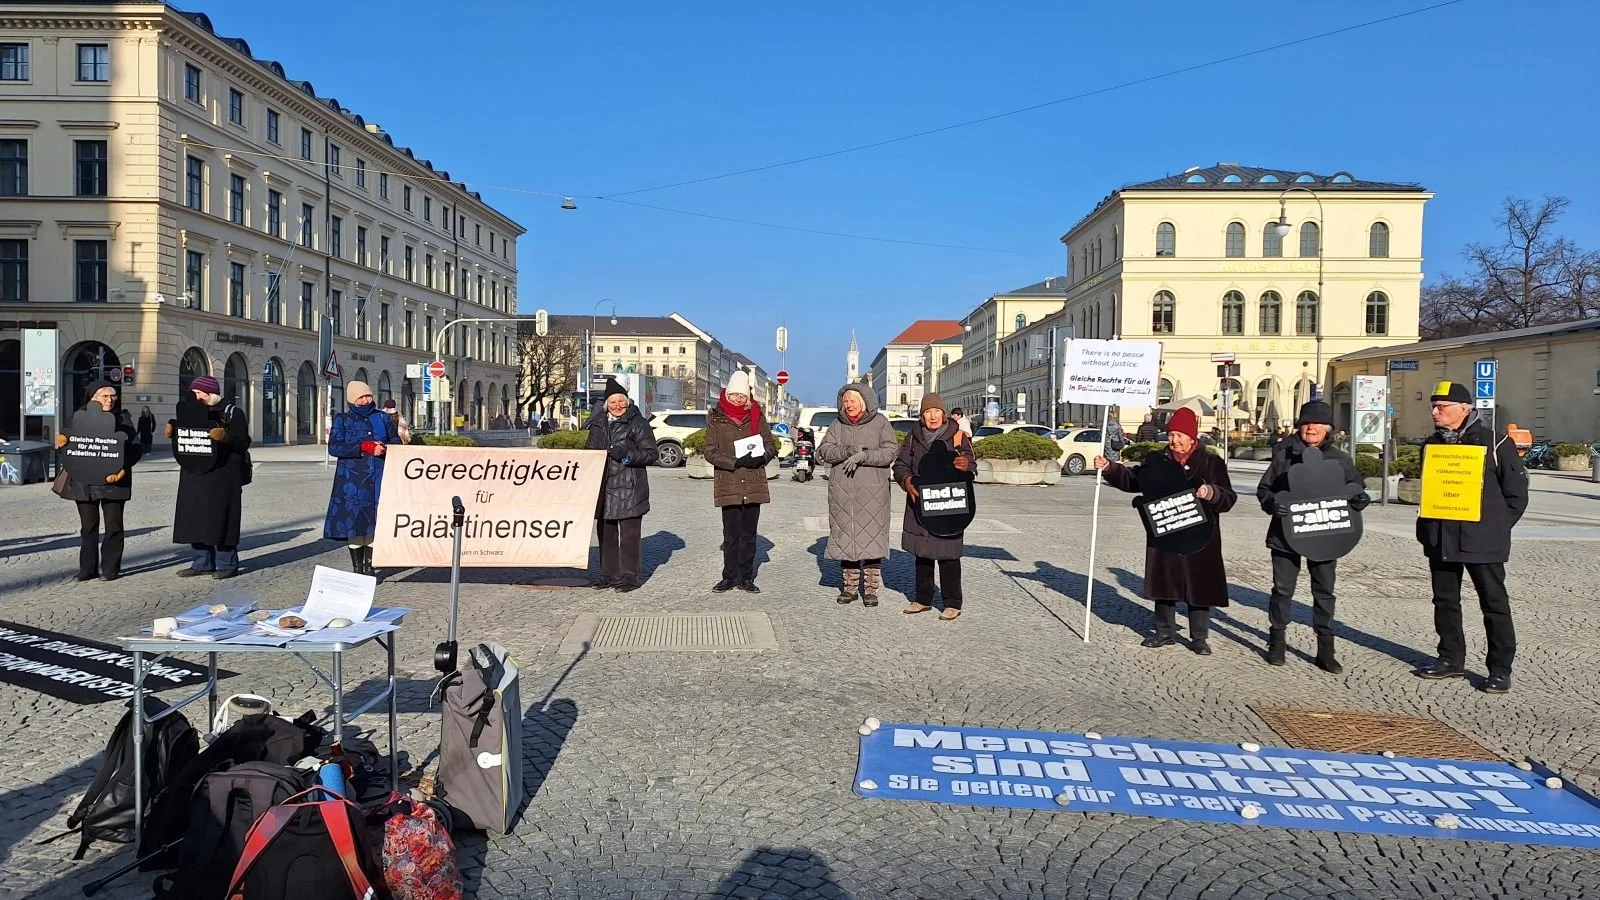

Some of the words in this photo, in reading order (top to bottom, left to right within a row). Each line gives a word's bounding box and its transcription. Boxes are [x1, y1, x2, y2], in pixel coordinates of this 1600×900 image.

[1081, 349, 1102, 357] There
[1480, 364, 1492, 377] U
[1070, 375, 1096, 383] Gleiche
[1123, 377, 1136, 385] für
[178, 429, 188, 437] End
[184, 445, 212, 454] Palestine
[404, 458, 580, 486] Gerechtigkeit
[475, 490, 495, 504] für
[922, 486, 950, 500] End
[952, 487, 966, 498] the
[923, 498, 966, 511] Occupation!
[1148, 492, 1195, 515] Schluss
[1290, 502, 1320, 512] Gleiche
[1320, 499, 1348, 509] Rechte
[1152, 512, 1164, 520] mit
[1164, 508, 1178, 517] den
[1292, 514, 1304, 522] für
[1304, 508, 1341, 524] alle
[1340, 510, 1349, 518] in
[393, 513, 574, 539] Palätinenser
[893, 728, 1533, 790] Menschenrechte
[931, 753, 1093, 783] sind
[1118, 766, 1531, 815] unteilbar!
[888, 775, 940, 792] Sie
[952, 779, 1054, 800] gelten
[1062, 784, 1117, 804] für
[1274, 802, 1345, 821] und
